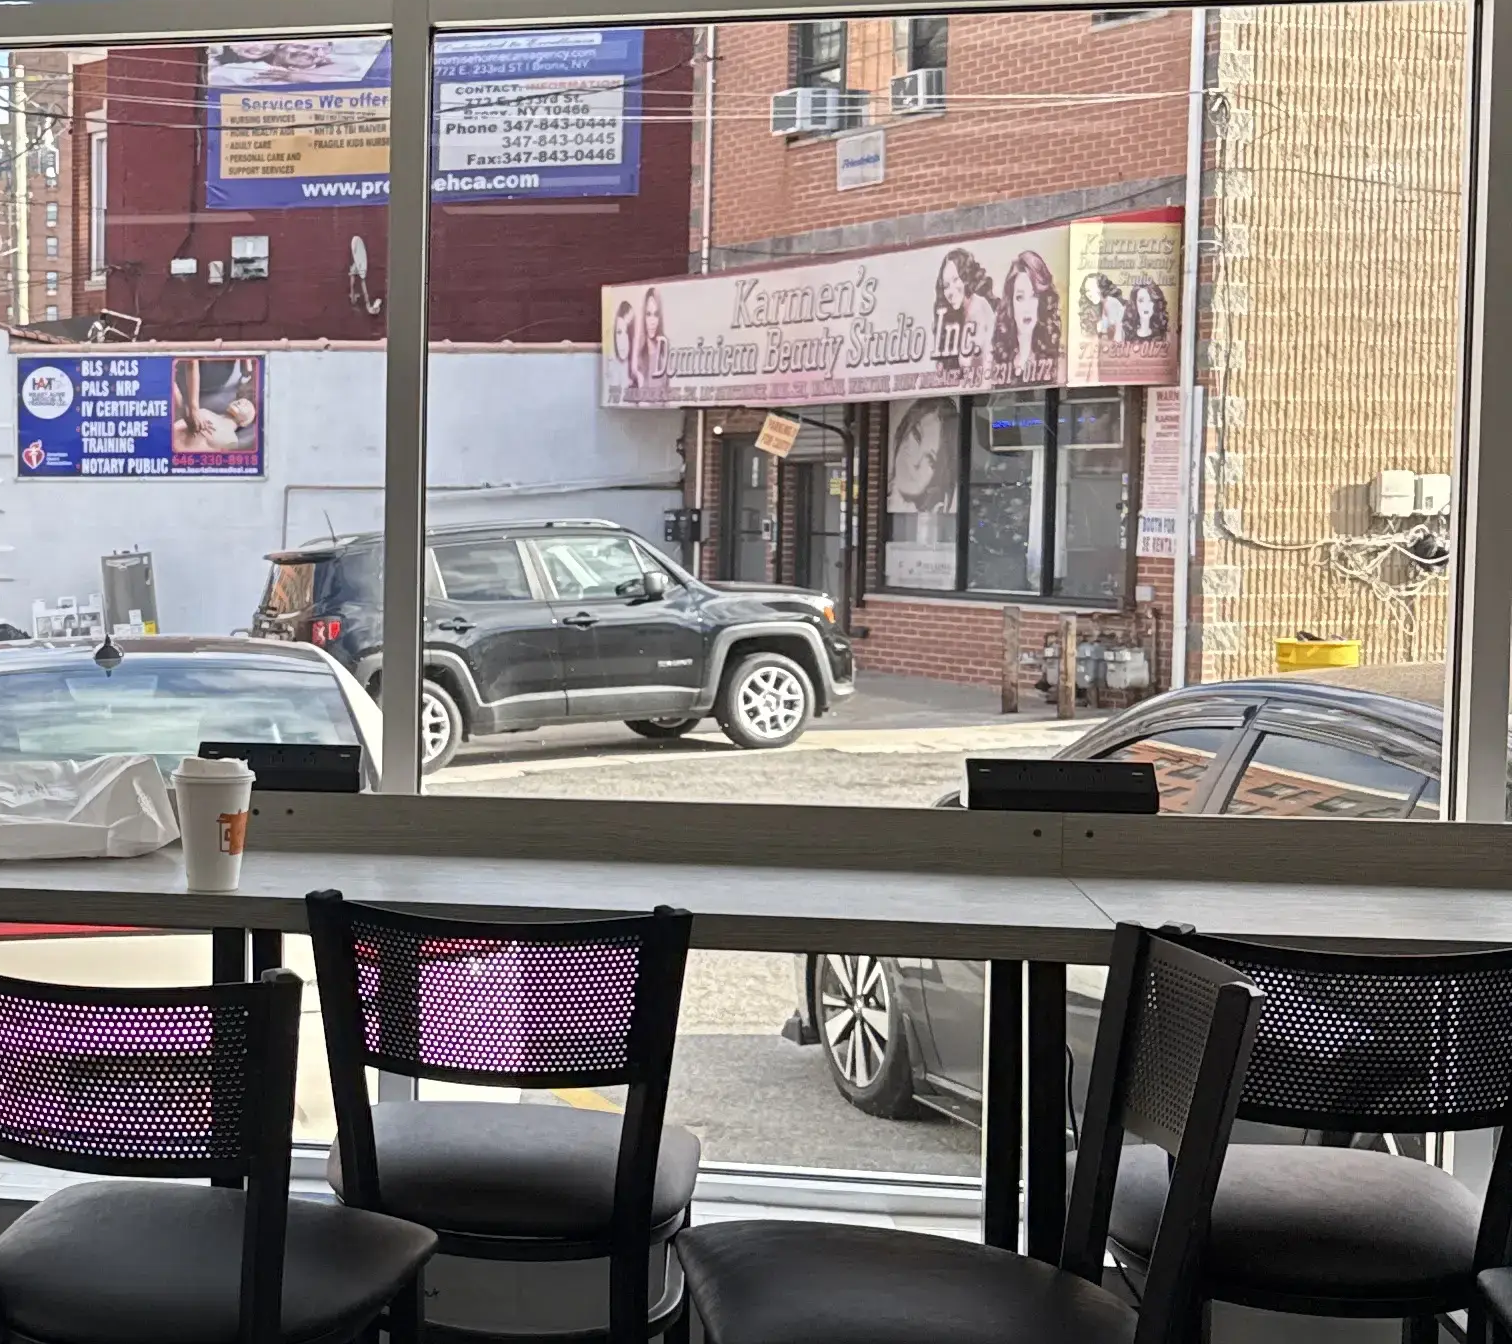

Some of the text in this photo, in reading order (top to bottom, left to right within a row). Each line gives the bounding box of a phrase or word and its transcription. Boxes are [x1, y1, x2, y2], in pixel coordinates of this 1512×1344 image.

[571, 59, 589, 69] NY
[241, 92, 389, 112] Services We offer
[516, 106, 538, 117] NY
[445, 122, 498, 135] Phone
[253, 139, 272, 149] CARE
[501, 132, 615, 148] 347-843-0445
[229, 151, 301, 163] PERSONAL CARE AND
[228, 164, 295, 175] SUPPORT SERVICES
[731, 265, 878, 329] Karmen's
[651, 307, 982, 380] Dominican Beauty Studio Inc.
[81, 359, 138, 377] BLS ACLS
[81, 380, 140, 397] PALS NRP
[81, 400, 94, 417] IV
[96, 400, 168, 417] CERTIFICATE
[81, 420, 148, 437] CHILD CARE
[82, 438, 135, 453] TRAINING
[81, 458, 126, 475] NOTARY
[127, 457, 169, 474] PUBLIC
